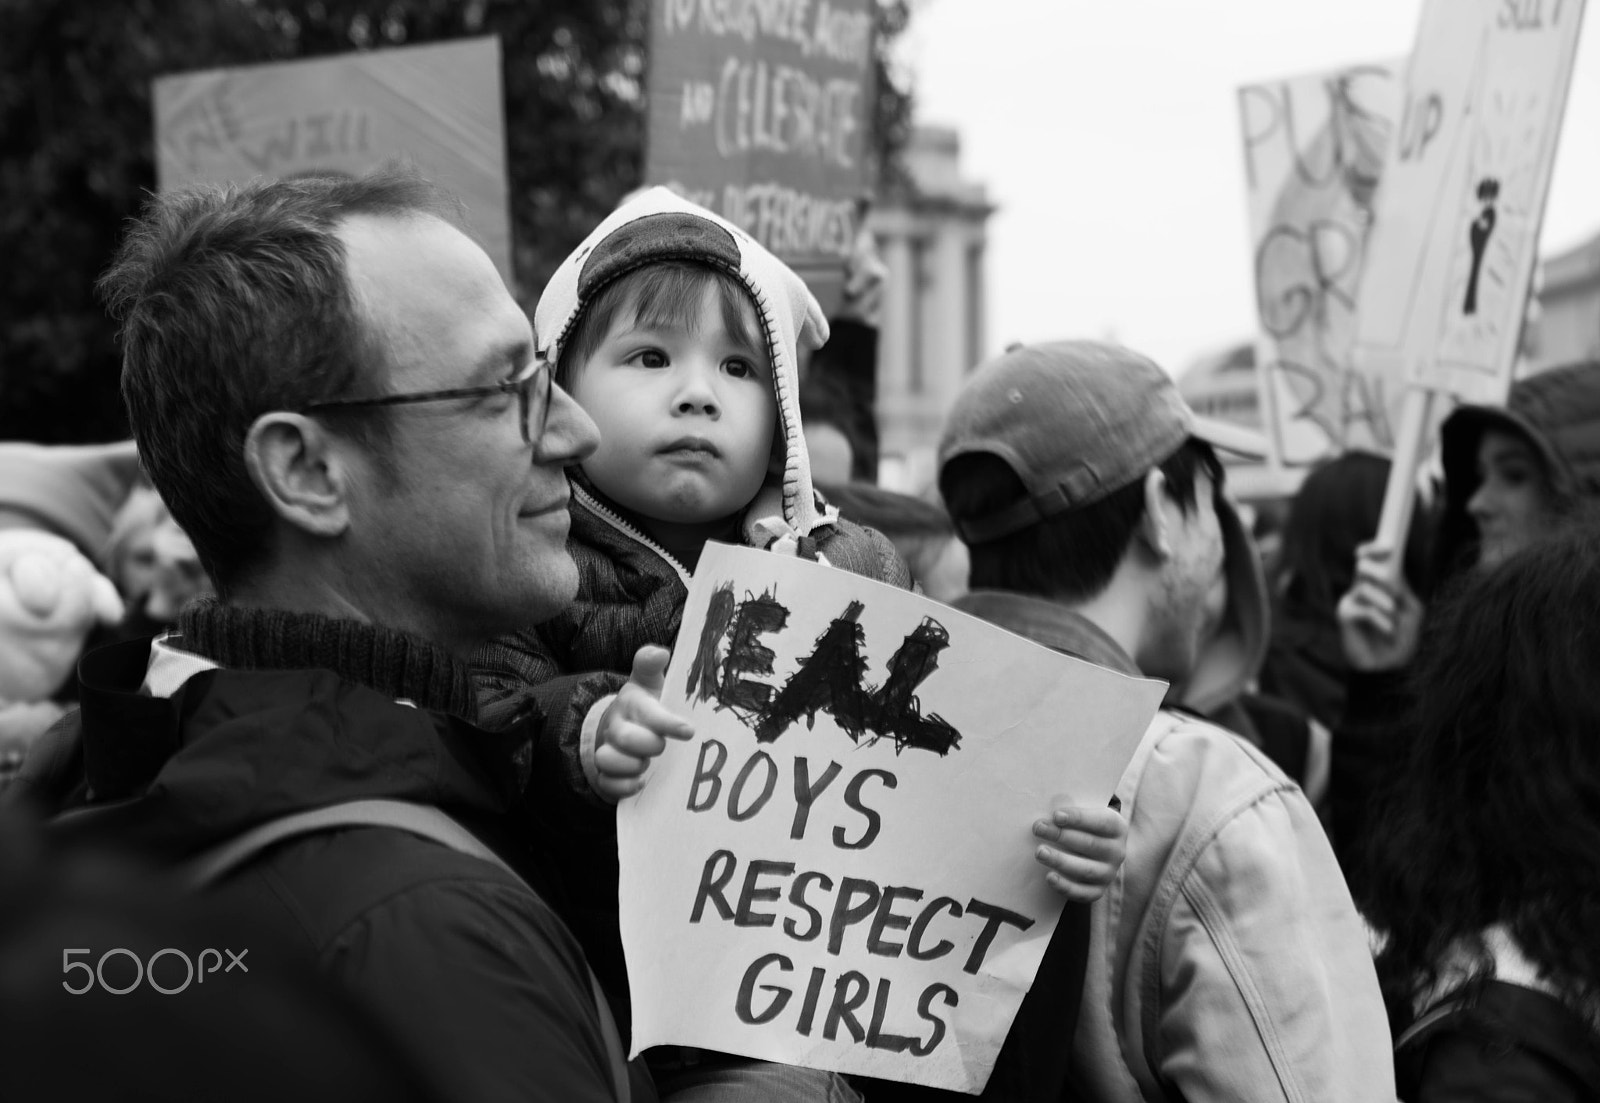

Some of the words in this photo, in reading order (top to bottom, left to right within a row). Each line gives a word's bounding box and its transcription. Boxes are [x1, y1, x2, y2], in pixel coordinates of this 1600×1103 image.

[686, 739, 898, 850] BOYS
[689, 849, 1035, 975] RESPECT
[735, 953, 959, 1057] GIRLS
